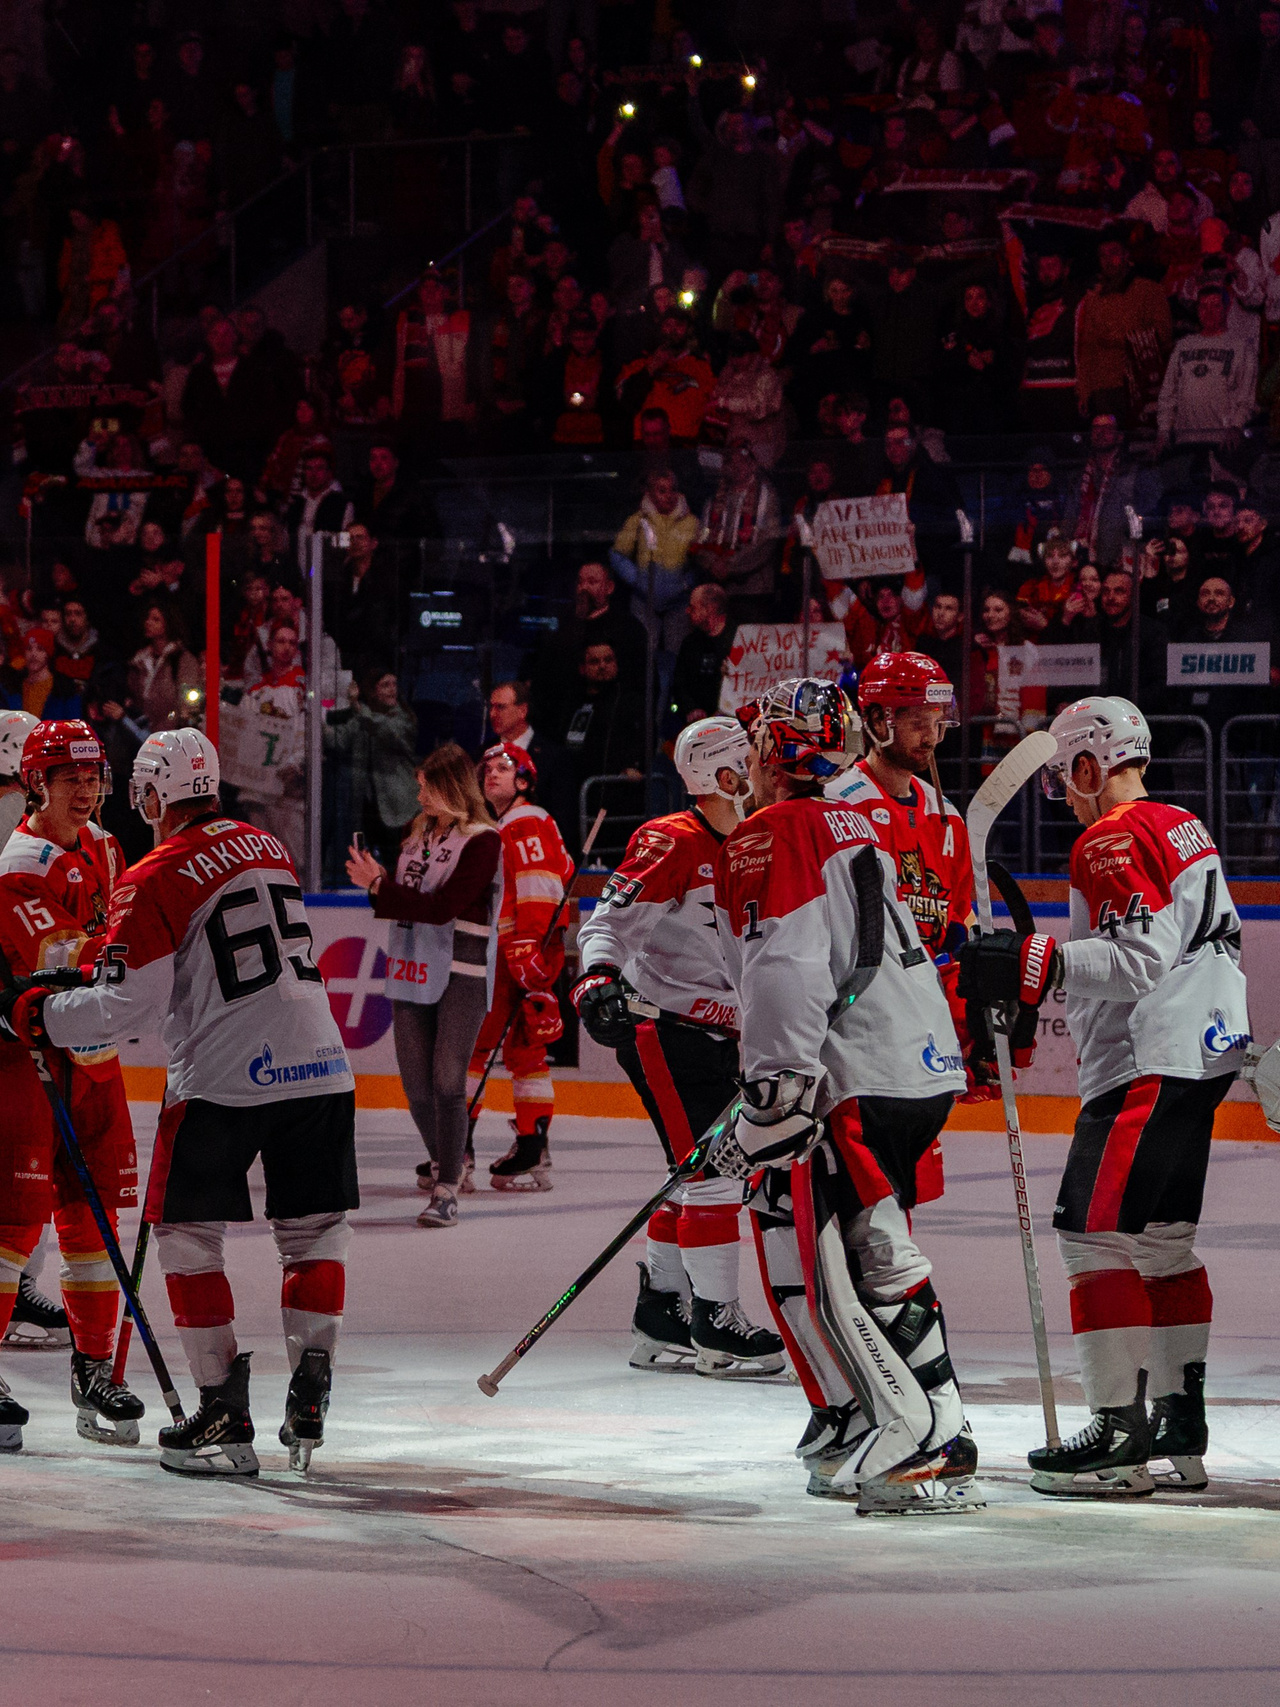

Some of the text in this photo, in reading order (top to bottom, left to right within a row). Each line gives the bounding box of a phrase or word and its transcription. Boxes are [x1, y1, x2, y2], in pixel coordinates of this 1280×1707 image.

[1180, 653, 1256, 674] SIBUR
[71, 746, 99, 754] согаз
[193, 776, 210, 794] 65
[515, 836, 545, 865] 13
[941, 823, 955, 858] A
[12, 897, 56, 938] 15
[742, 900, 763, 943] 1
[1098, 892, 1154, 939] 44
[204, 883, 323, 1003] 65
[1006, 1119, 1032, 1232] JETSPEED
[852, 1316, 905, 1397] SUPREME
[191, 1412, 231, 1448] CCM
